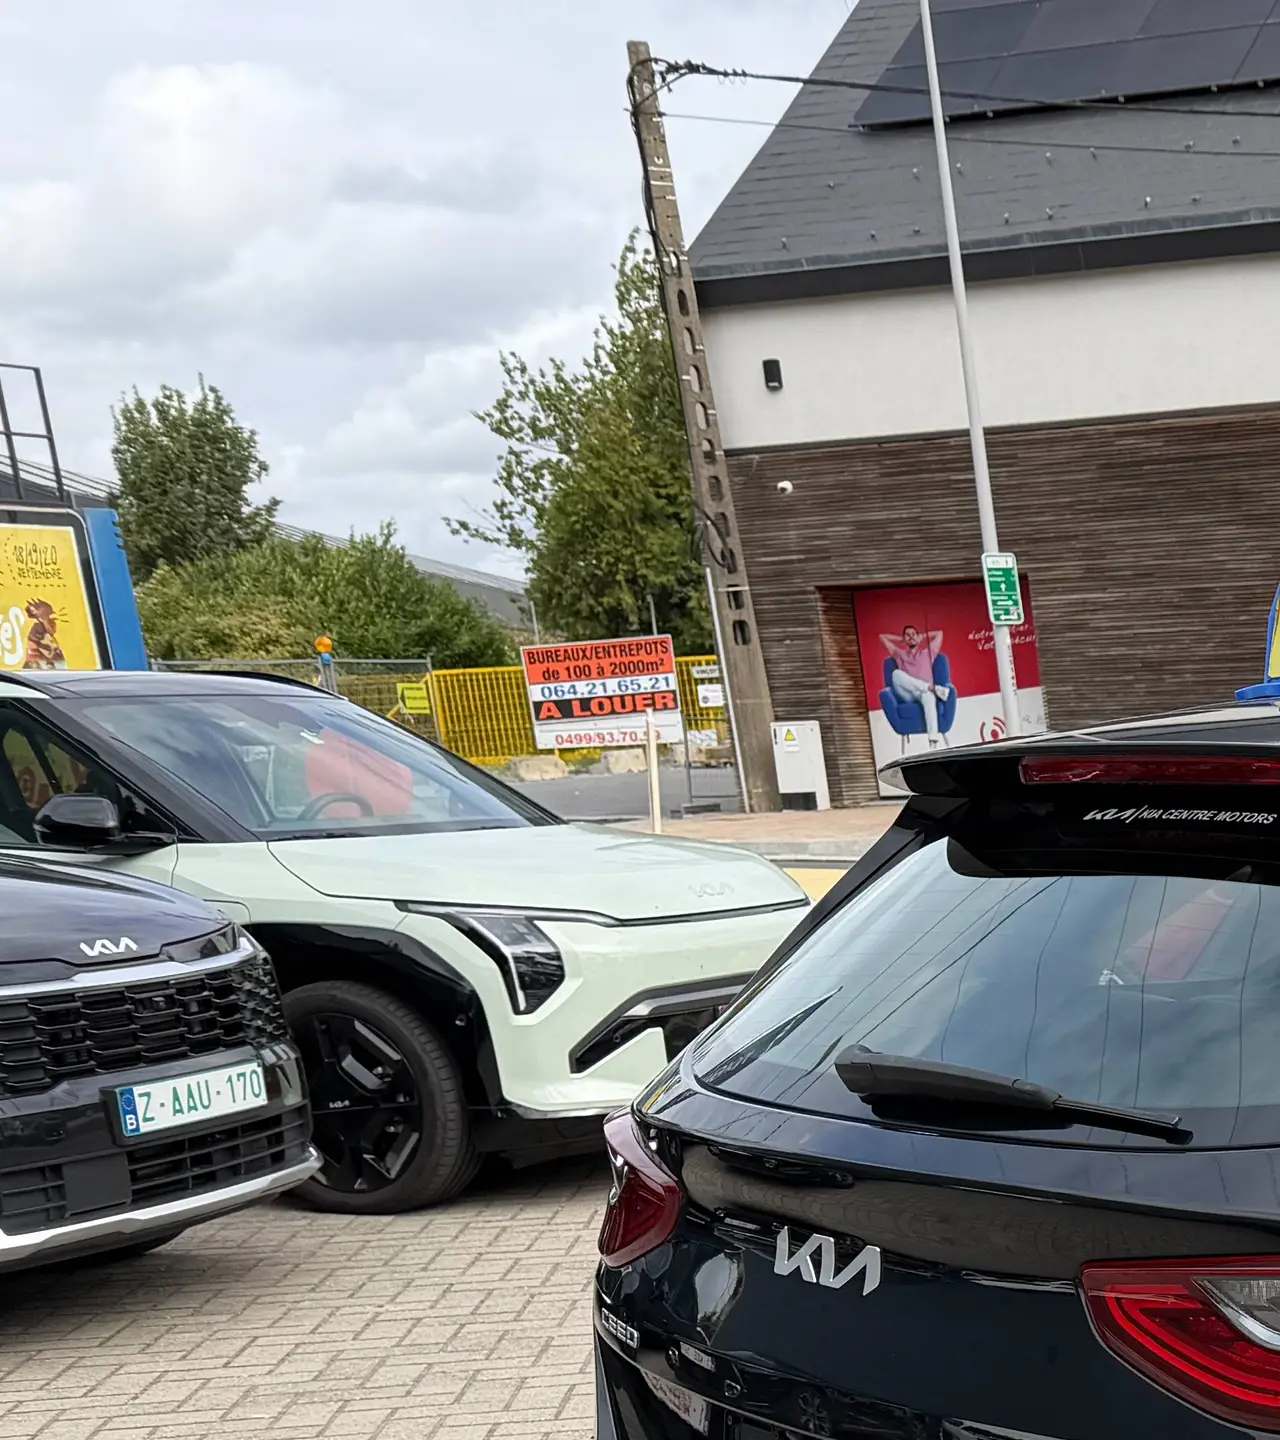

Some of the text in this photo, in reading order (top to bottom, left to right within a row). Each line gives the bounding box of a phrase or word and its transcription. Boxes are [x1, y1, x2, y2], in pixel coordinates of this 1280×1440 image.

[17, 567, 64, 580] SEPTEMBRE
[527, 640, 669, 665] BUREAUX/ENTREPOTS
[542, 658, 665, 681] de 100 à 2000m²
[541, 676, 671, 699] 064.21.65.21
[538, 692, 677, 720] A LOUER
[1138, 809, 1163, 819] KIA
[1162, 809, 1218, 821] CENTRE
[1213, 811, 1278, 824] MOTORS
[125, 1114, 137, 1129] B
[774, 1226, 881, 1296] KIA
